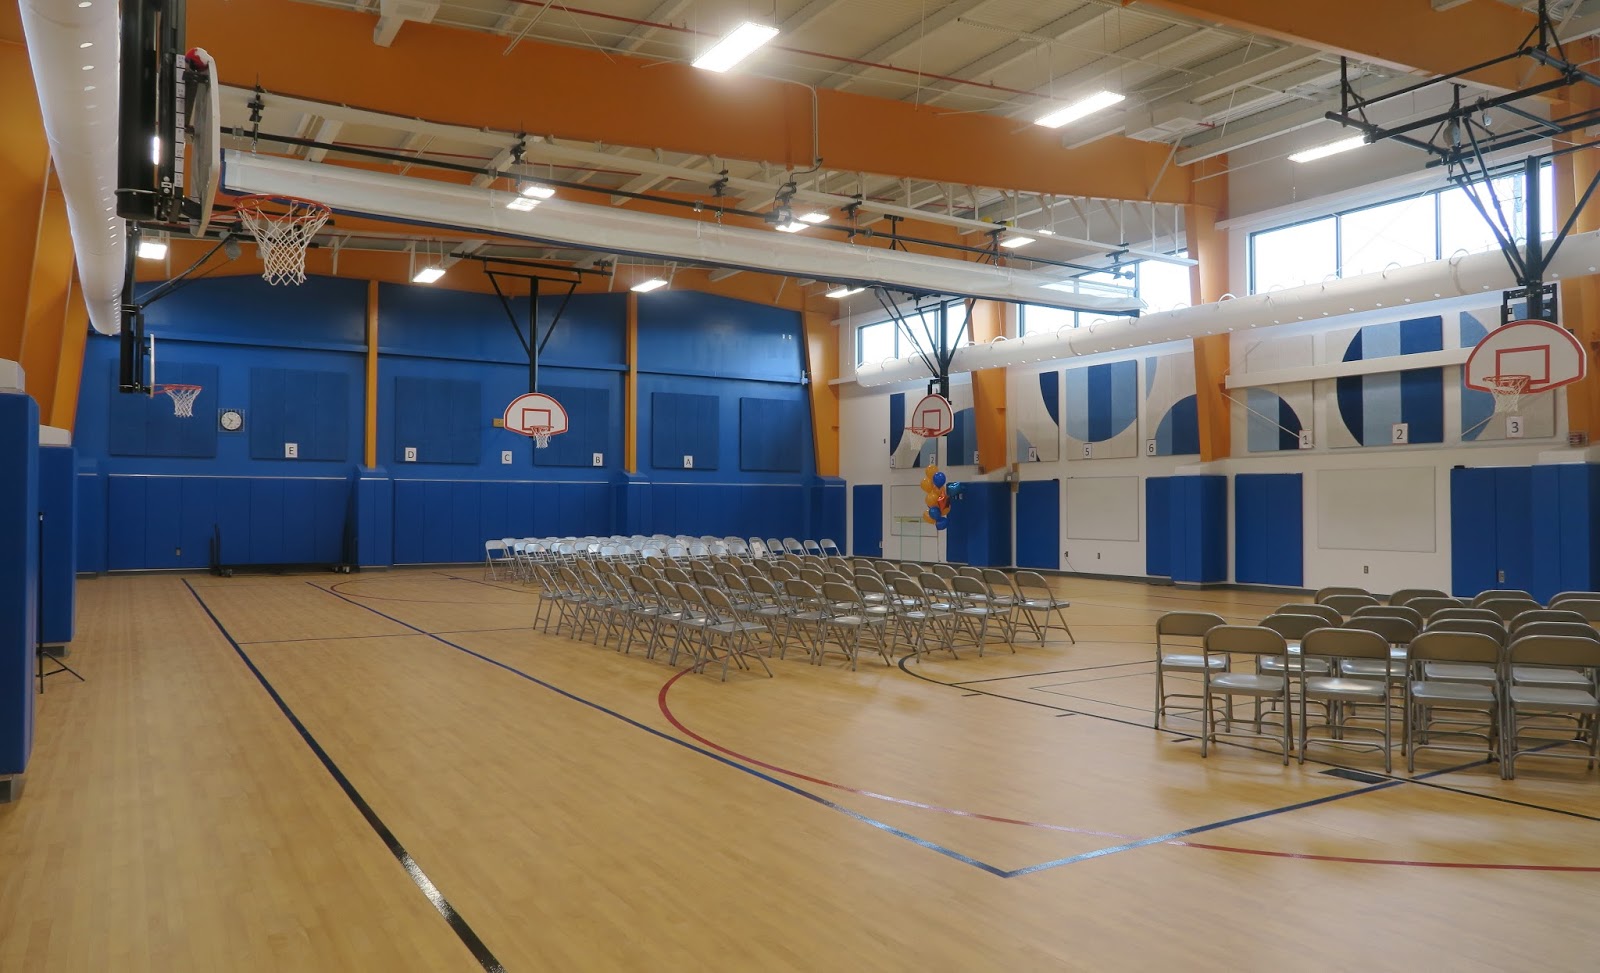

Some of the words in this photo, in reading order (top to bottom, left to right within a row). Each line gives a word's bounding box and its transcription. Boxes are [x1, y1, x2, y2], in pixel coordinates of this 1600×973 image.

[1511, 421, 1519, 433] 3
[1396, 429, 1403, 440] 2
[1303, 435, 1309, 445] 1
[289, 446, 294, 455] E
[1148, 443, 1154, 453] 6
[408, 450, 414, 459] D
[504, 453, 510, 462] C
[595, 456, 601, 464] B
[685, 458, 692, 466] A
